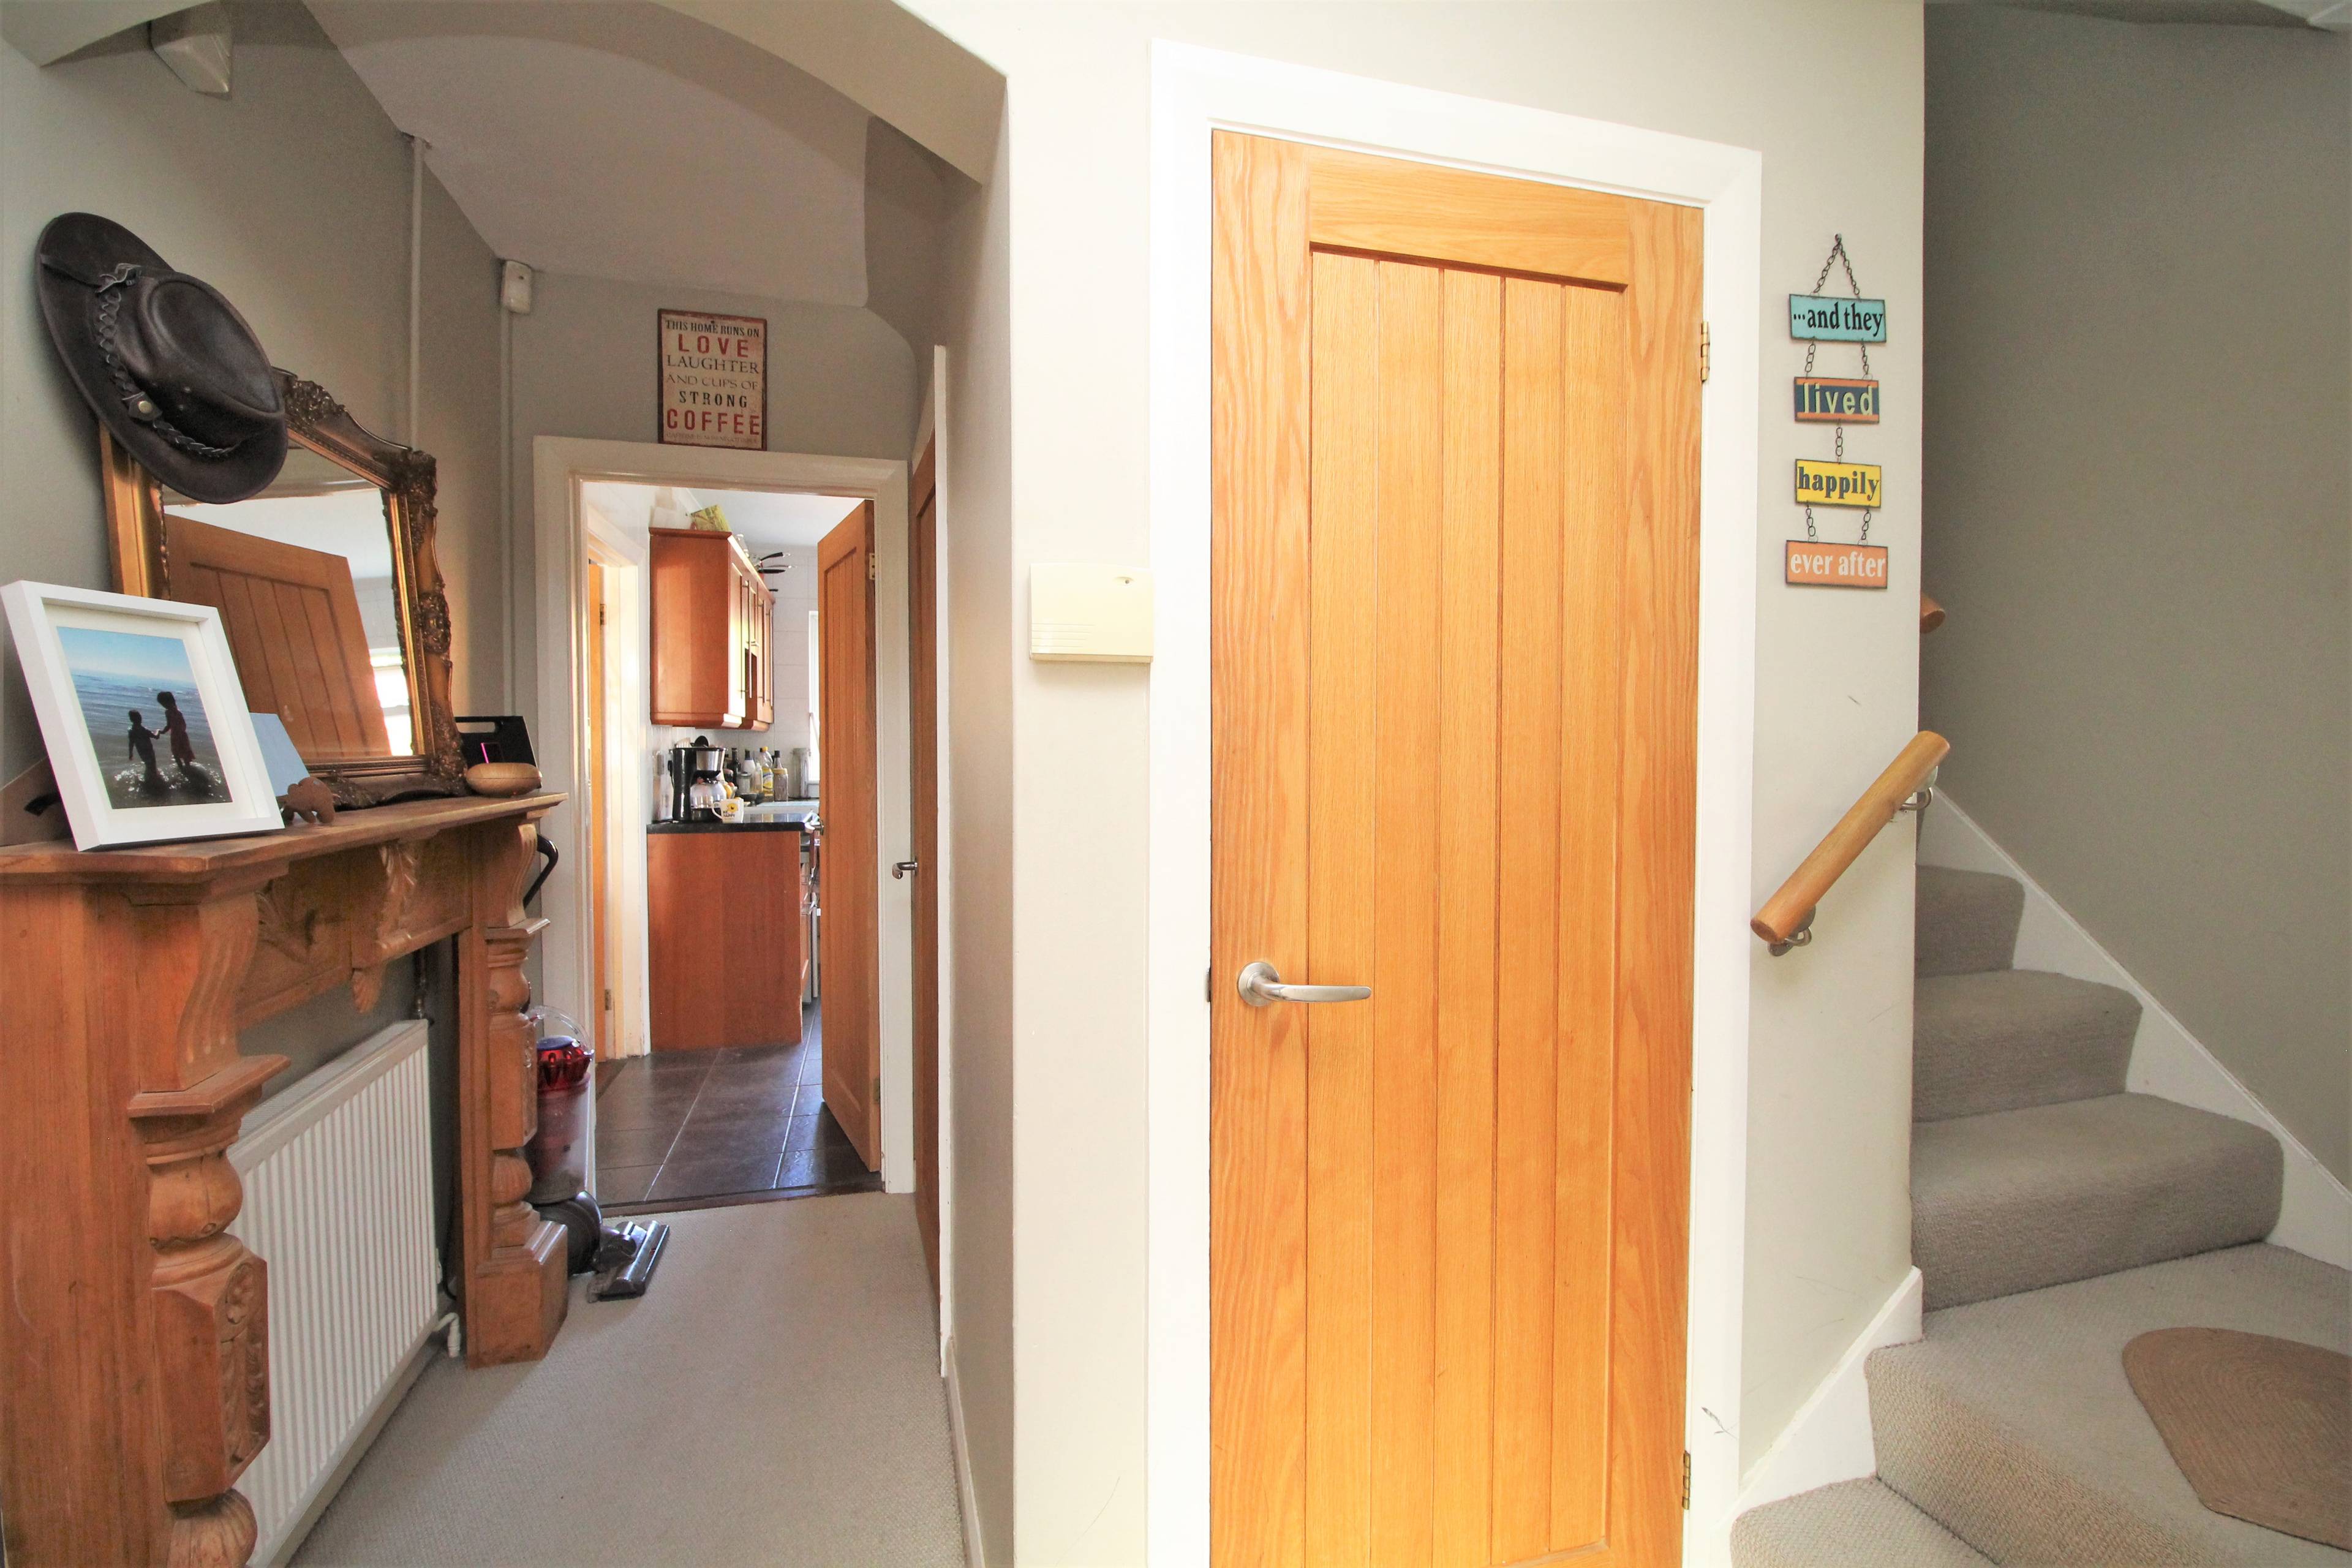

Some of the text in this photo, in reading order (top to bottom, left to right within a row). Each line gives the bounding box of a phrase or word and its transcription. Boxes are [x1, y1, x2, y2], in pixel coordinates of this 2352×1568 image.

[666, 320, 760, 337] THIS HOME RUNS ON
[1844, 303, 1883, 337] they
[678, 334, 748, 358] LOVE
[667, 355, 760, 374] LAUGHTER
[666, 374, 758, 390] AND CUPS OF
[679, 391, 747, 409] STRONG
[1803, 382, 1873, 416] lived
[667, 409, 760, 435] COFFEE
[1798, 466, 1879, 501] happily
[1790, 551, 1885, 578] ever after
